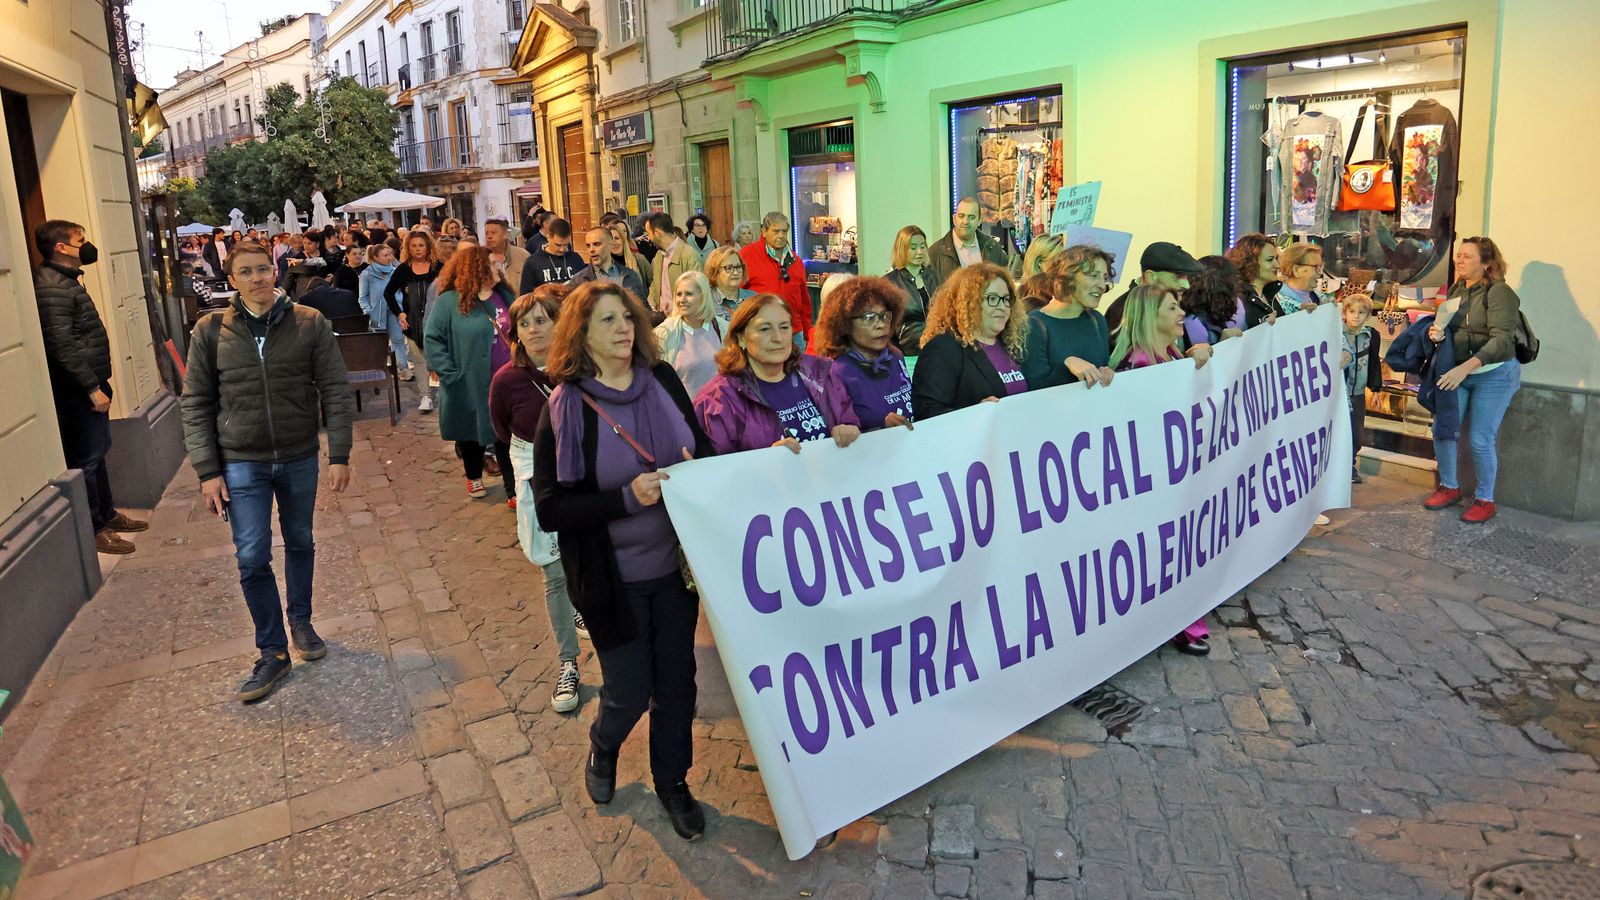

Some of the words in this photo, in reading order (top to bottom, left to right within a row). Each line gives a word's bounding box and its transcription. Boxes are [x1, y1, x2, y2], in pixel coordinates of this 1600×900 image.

[741, 461, 995, 614] CONSEJO
[1009, 420, 1152, 534] LOCAL
[1163, 402, 1204, 486] DE
[1206, 380, 1240, 463] LAS
[1242, 341, 1332, 437] MUJERES
[986, 572, 1055, 670] LA
[1060, 487, 1229, 636] VIOLENCIA
[1235, 464, 1261, 538] DE
[1262, 419, 1333, 514] GÉNERO
